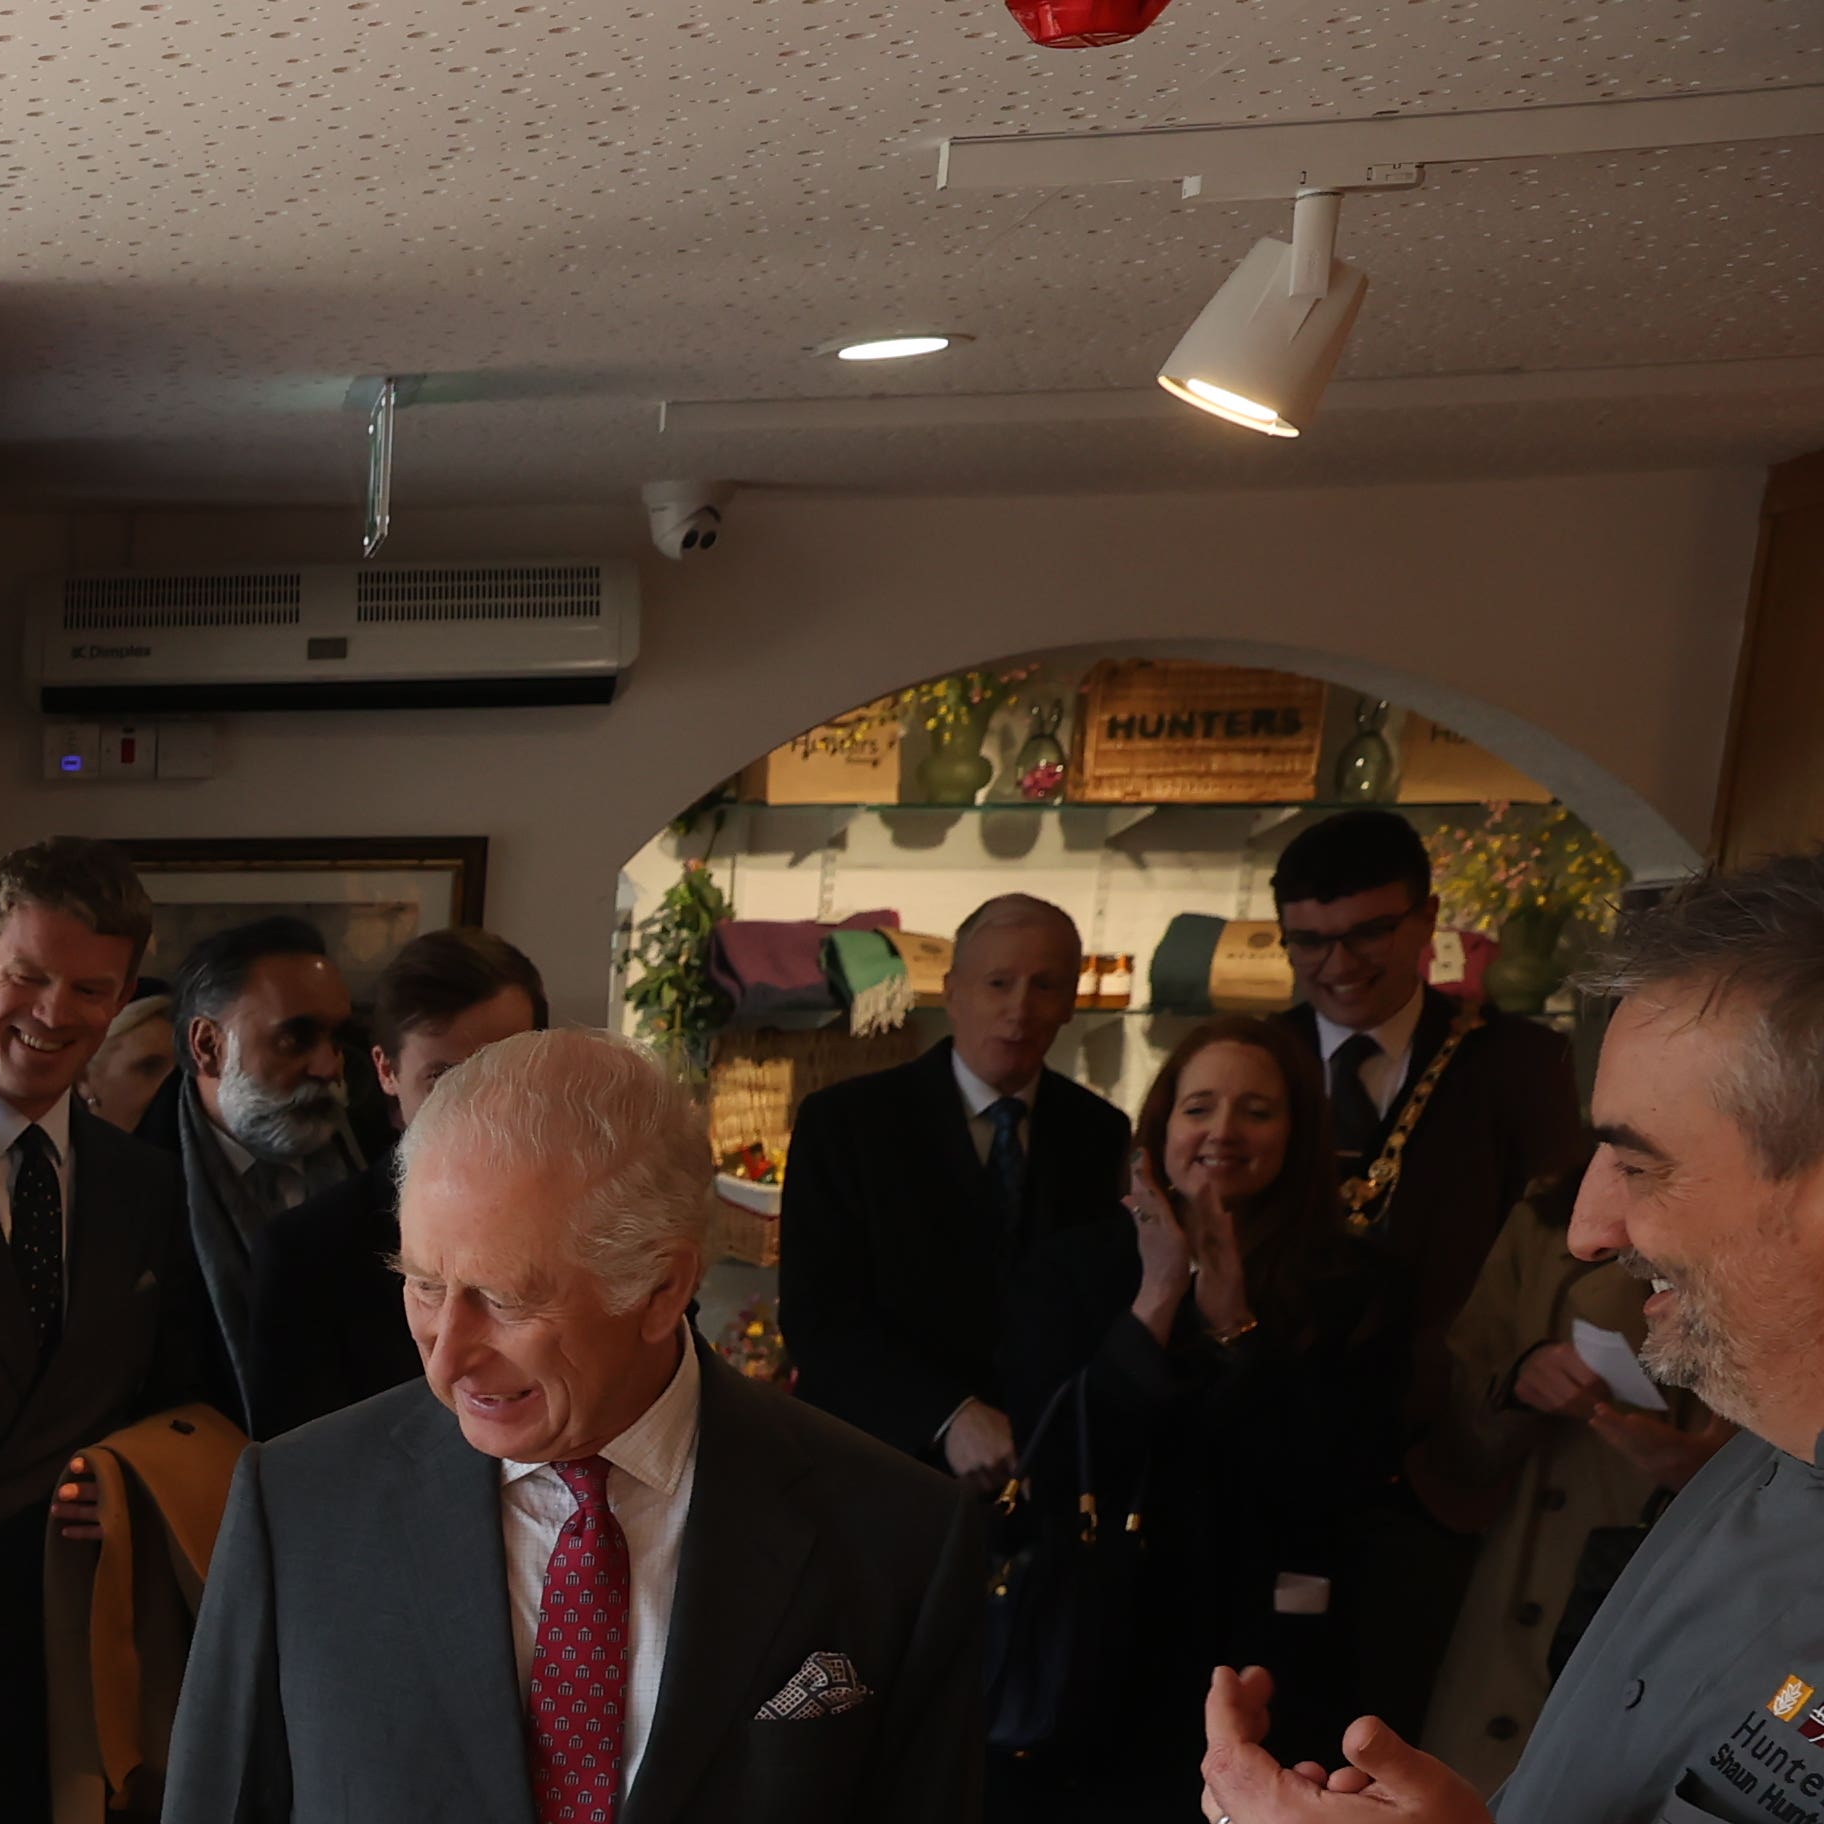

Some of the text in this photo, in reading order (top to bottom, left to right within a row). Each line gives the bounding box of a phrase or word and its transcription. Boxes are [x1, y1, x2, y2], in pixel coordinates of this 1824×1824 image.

[90, 645, 152, 659] Dimplex
[1106, 708, 1304, 739] HUNTERS
[1709, 1742, 1759, 1796] Shaun
[1731, 1710, 1824, 1806] Hunte
